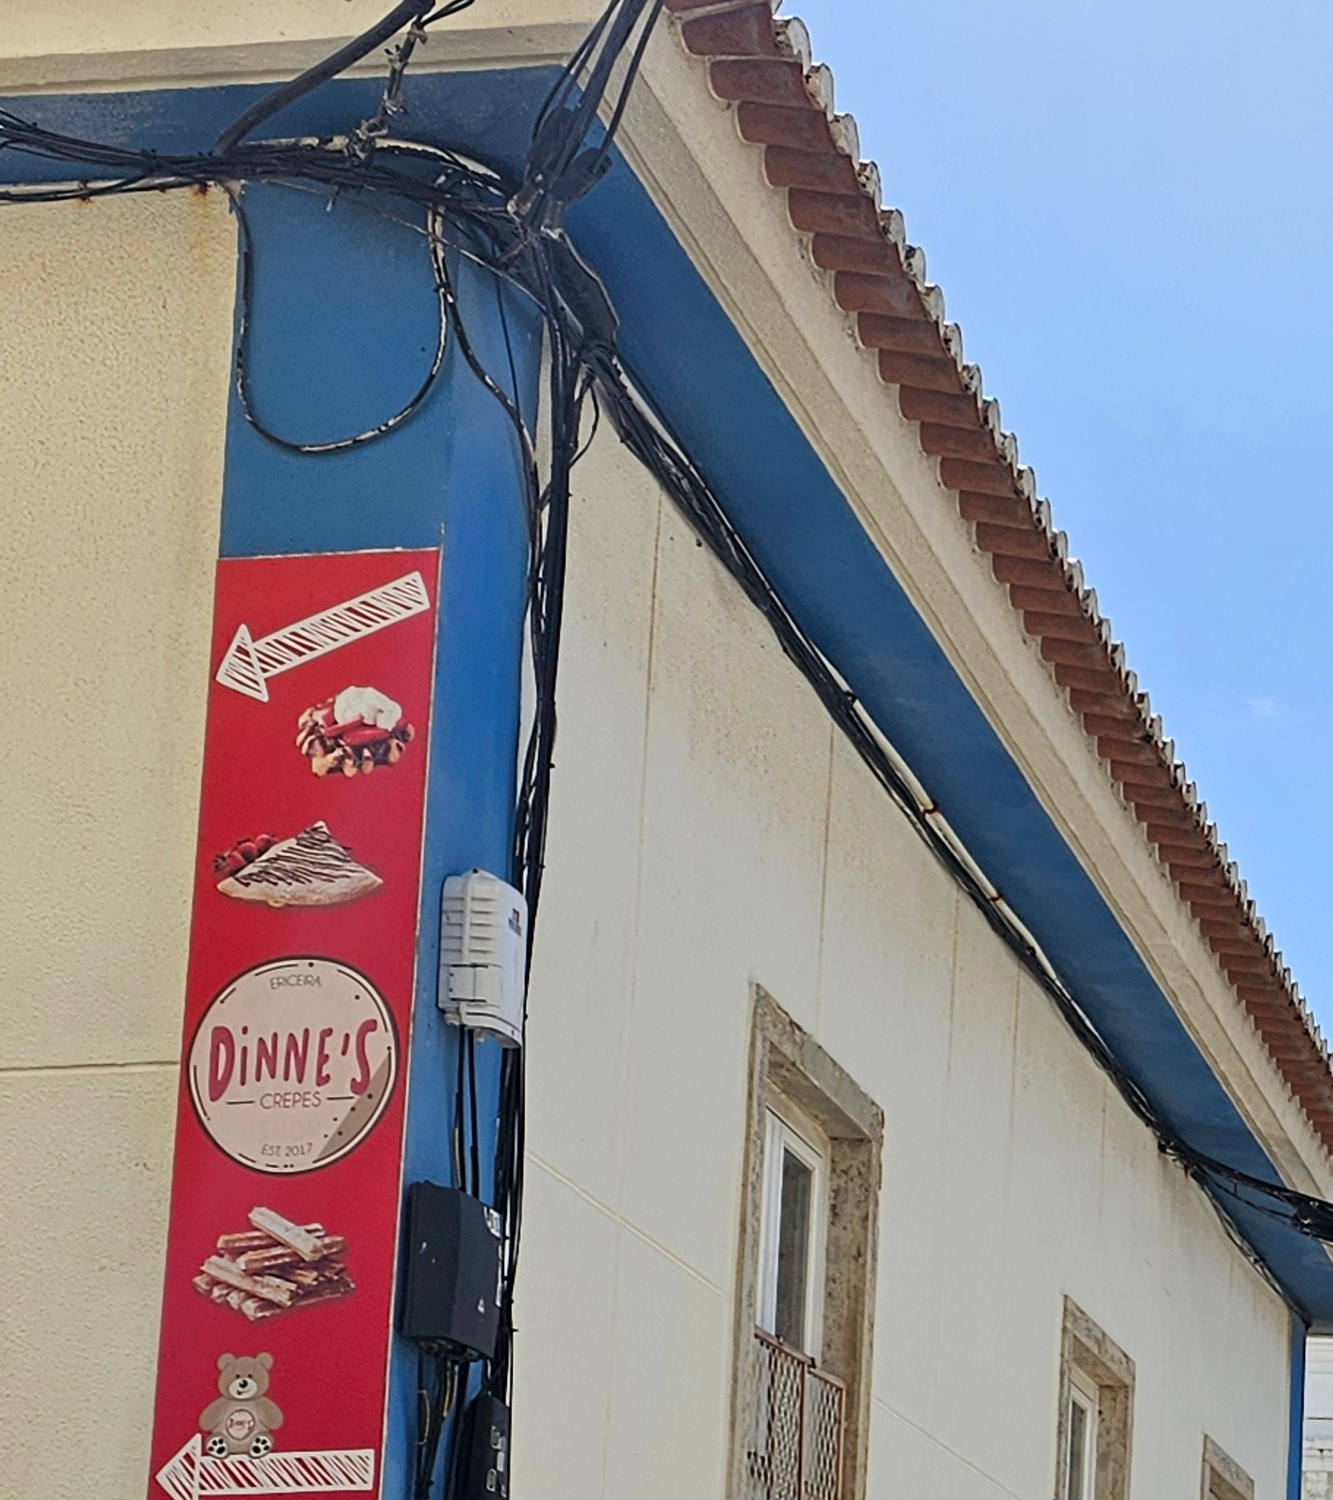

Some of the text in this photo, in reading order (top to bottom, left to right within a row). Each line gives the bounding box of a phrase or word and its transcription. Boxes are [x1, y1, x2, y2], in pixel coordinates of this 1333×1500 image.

[269, 975, 321, 990] ERICEIRA
[259, 1091, 322, 1109] CREPES
[284, 1142, 313, 1156] 2017
